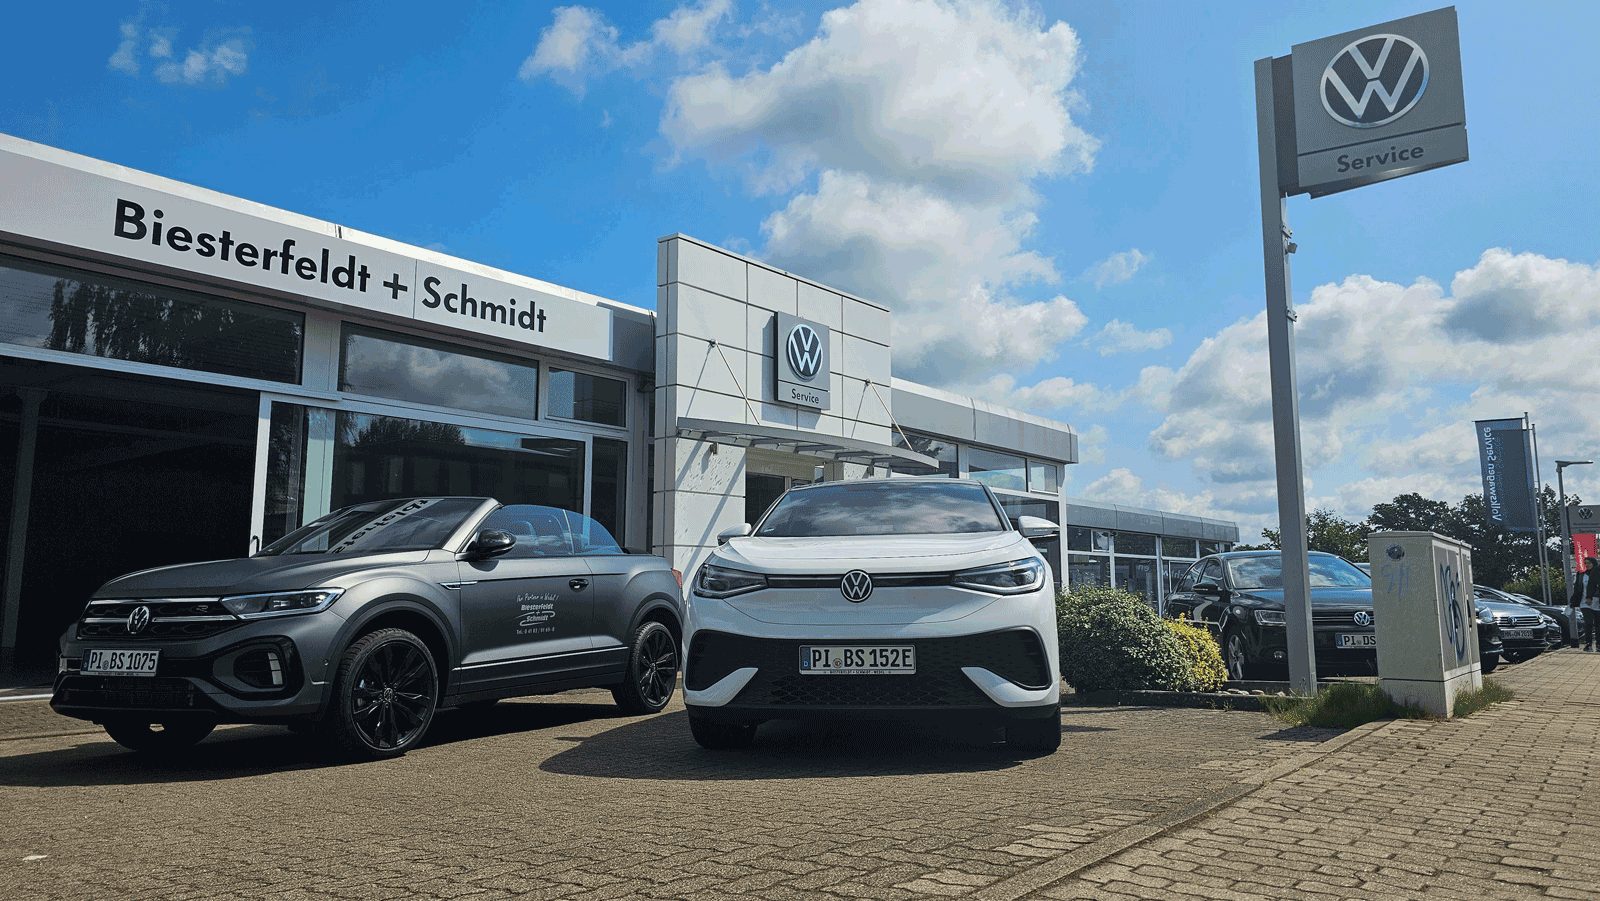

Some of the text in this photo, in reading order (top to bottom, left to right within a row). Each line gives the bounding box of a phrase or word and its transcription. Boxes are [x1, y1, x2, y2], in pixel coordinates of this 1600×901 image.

[1336, 146, 1425, 173] Service
[113, 198, 547, 333] Biesterfeldt + Schmidt
[791, 388, 820, 404] Service
[520, 603, 554, 611] Biesterfeldt
[1343, 635, 1376, 646] PI DS
[90, 652, 157, 671] PI BS 1075
[812, 648, 831, 668] PI
[843, 648, 865, 668] BS
[869, 648, 913, 668] 152E
